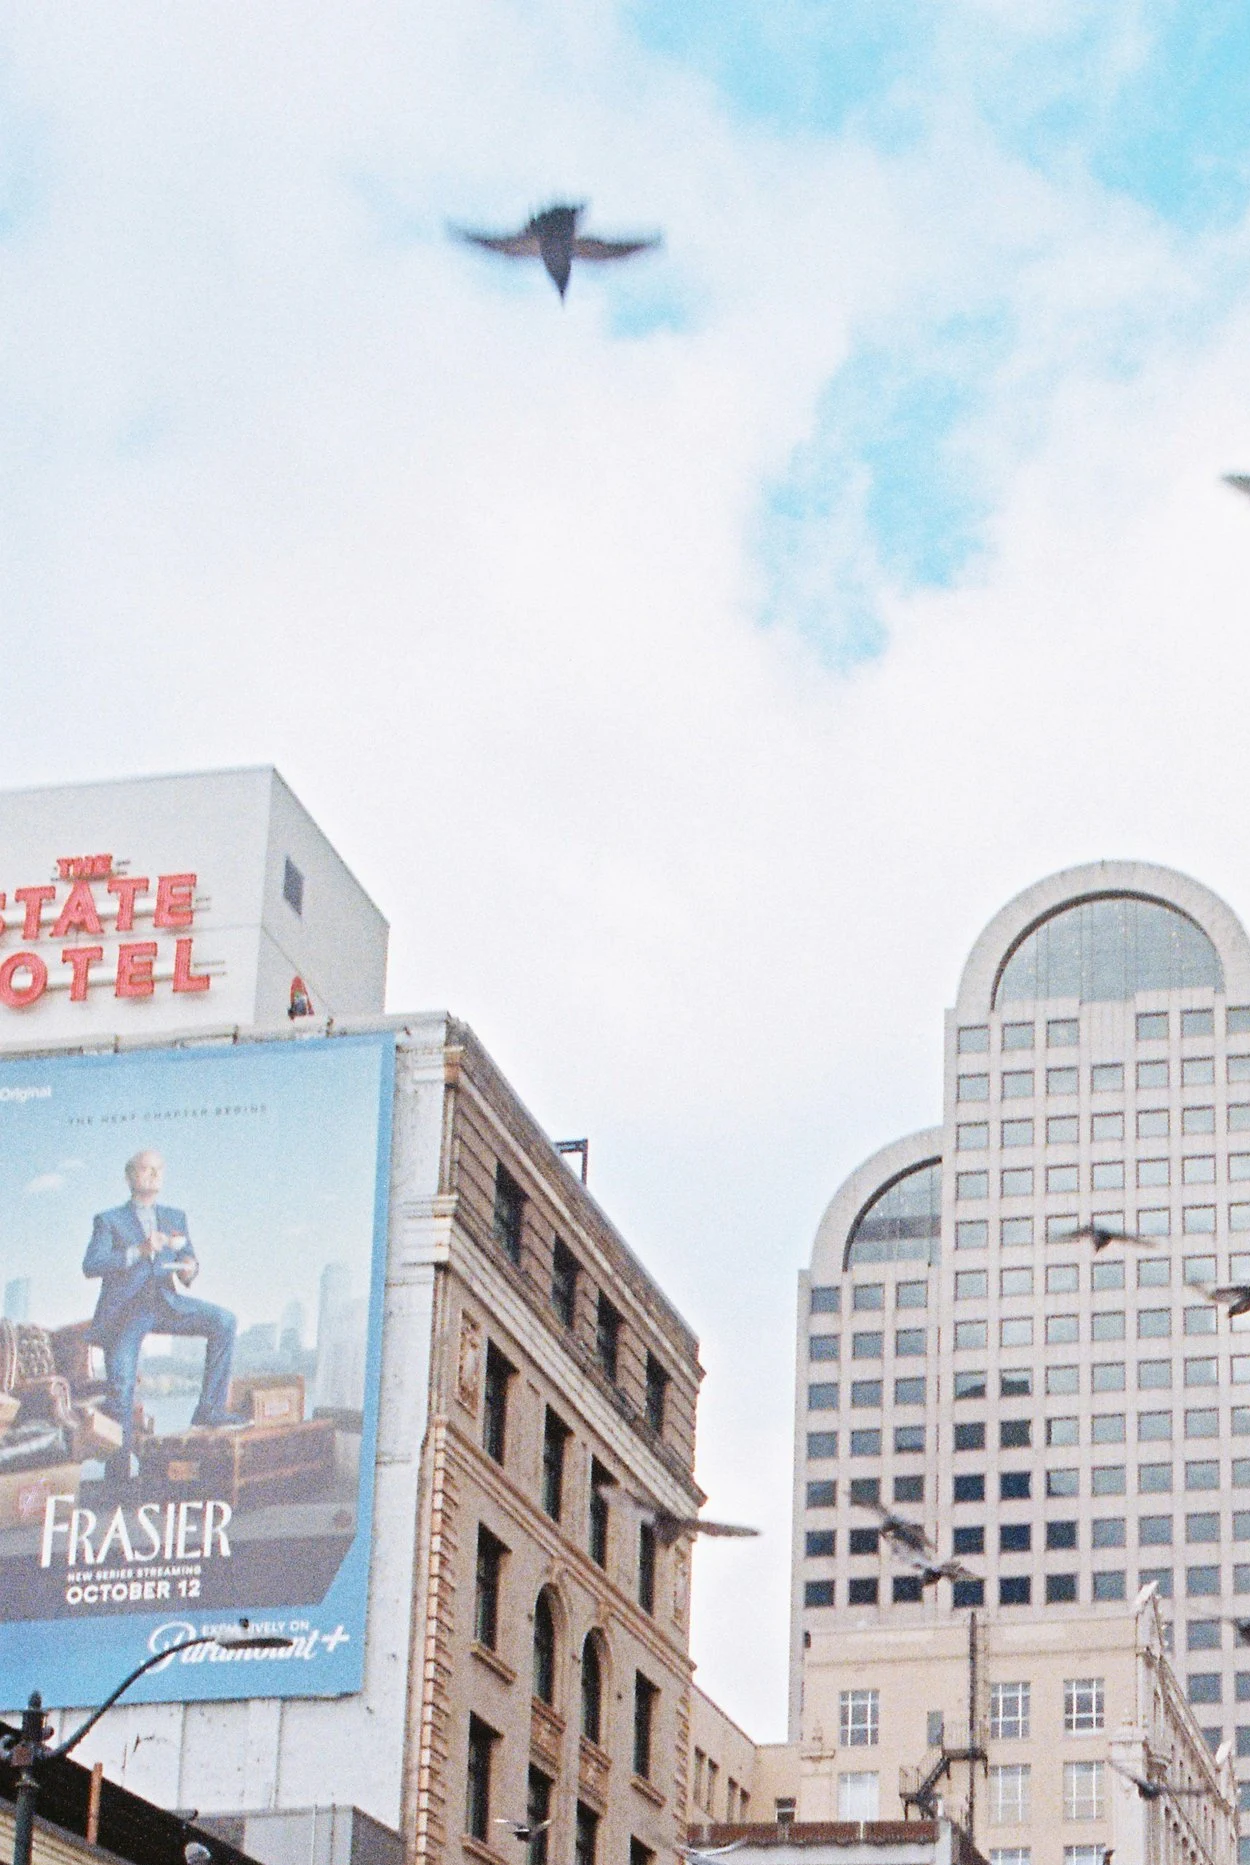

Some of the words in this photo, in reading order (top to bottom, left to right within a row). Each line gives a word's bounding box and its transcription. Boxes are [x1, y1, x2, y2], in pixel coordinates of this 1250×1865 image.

[56, 854, 113, 881] THE
[0, 874, 197, 941] TATE
[41, 1495, 232, 1568] FRASIER
[67, 1571, 93, 1582] NEW
[96, 1567, 134, 1580] SERIES
[137, 1564, 202, 1577] STREAMING
[66, 1582, 170, 1604] OCTOBER
[178, 1579, 201, 1597] 12
[289, 1621, 310, 1632] ON
